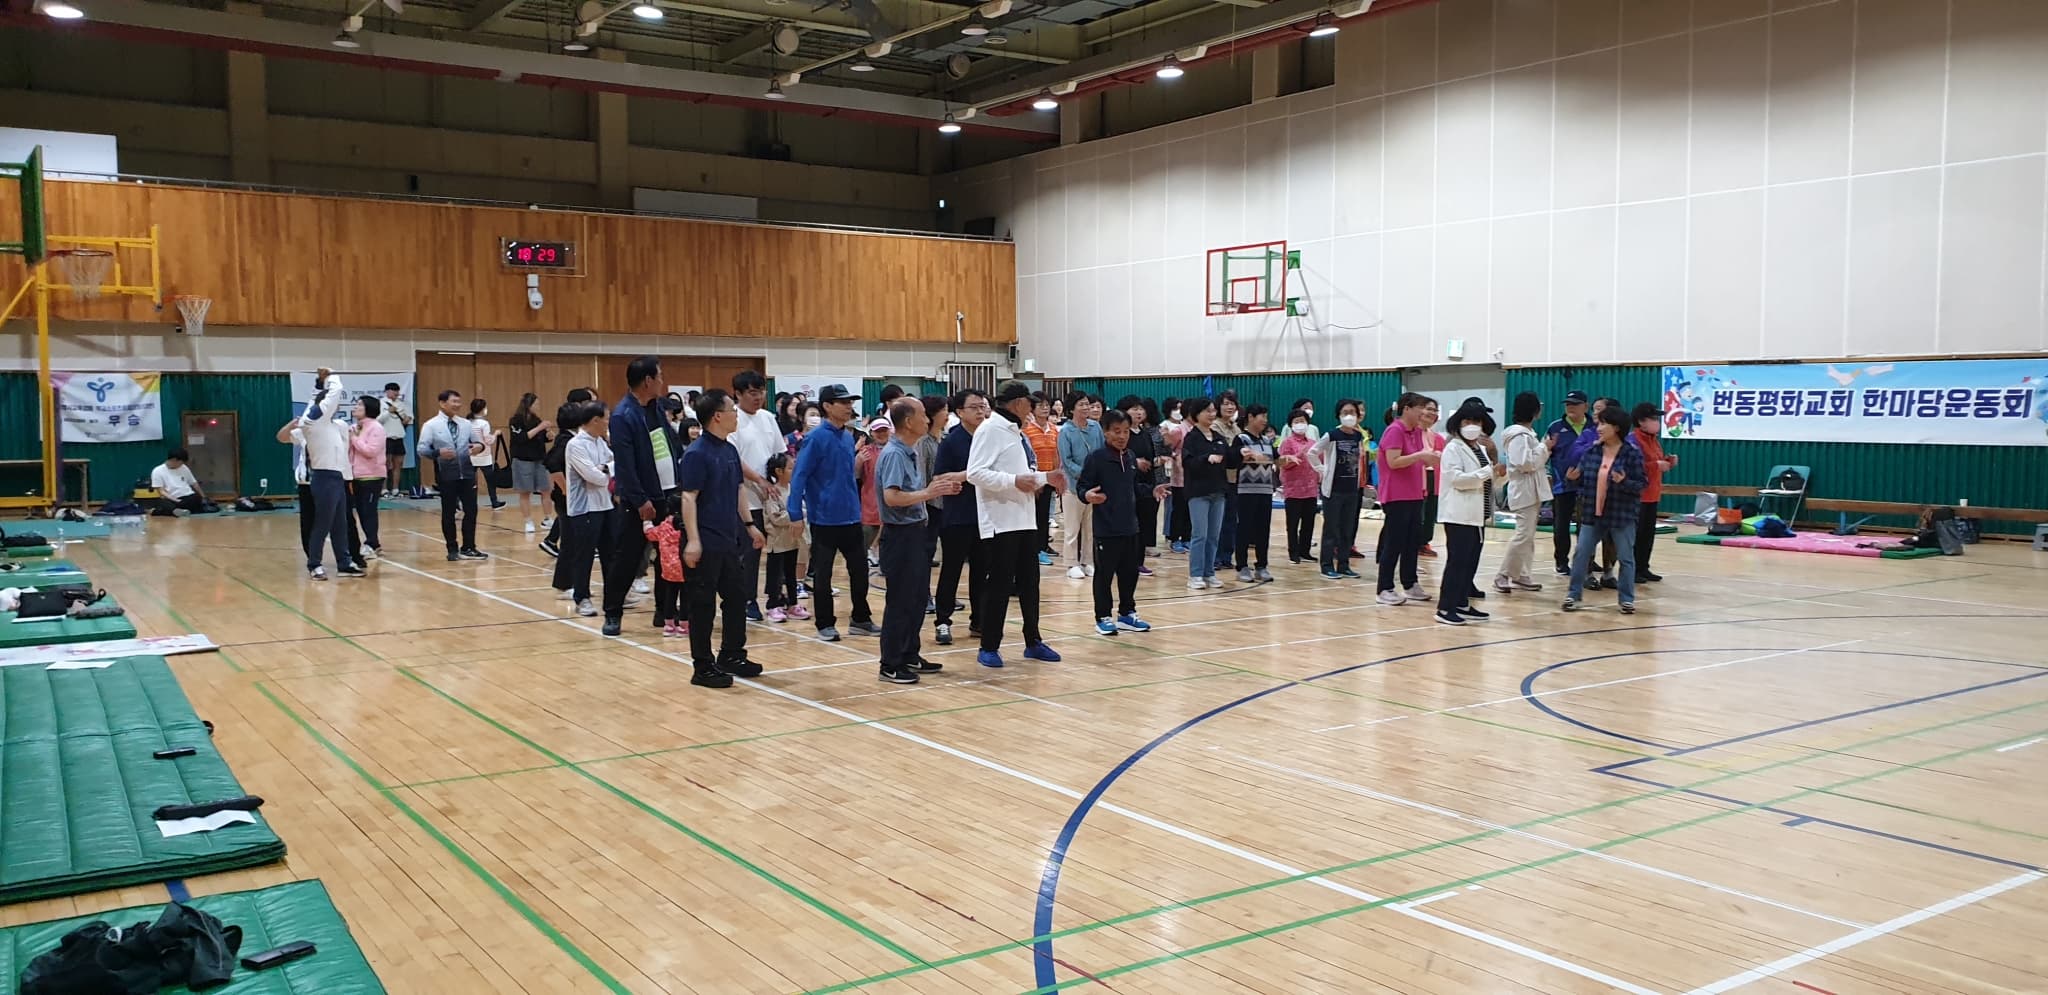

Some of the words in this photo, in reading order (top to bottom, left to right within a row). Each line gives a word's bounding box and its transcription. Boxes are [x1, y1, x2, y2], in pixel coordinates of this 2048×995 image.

[538, 249, 555, 261] 29
[1712, 389, 1855, 417] 번동평화교회
[1862, 388, 2034, 418] 한마당운동회
